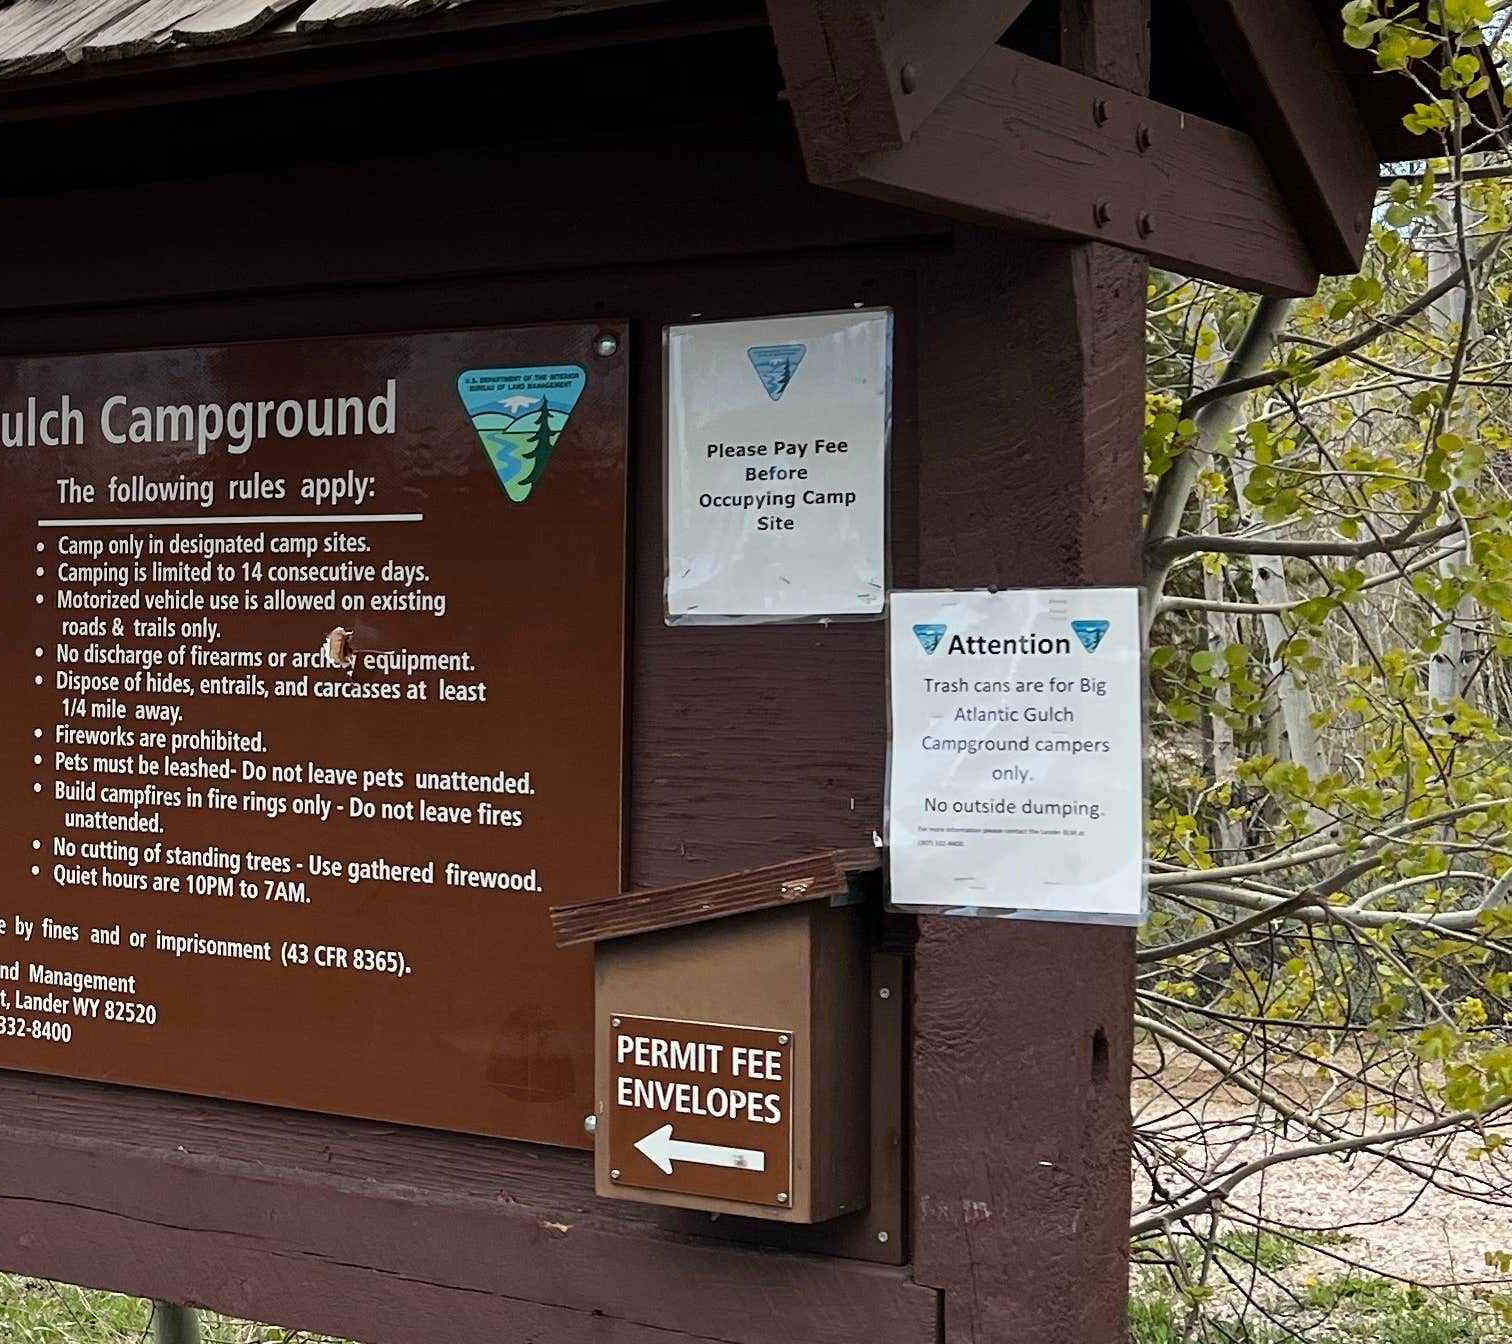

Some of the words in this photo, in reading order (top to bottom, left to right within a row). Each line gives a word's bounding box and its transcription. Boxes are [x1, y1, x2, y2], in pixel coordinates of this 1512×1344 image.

[100, 378, 397, 456] Campground
[707, 443, 768, 459] Please
[774, 441, 809, 459] Pay
[815, 439, 849, 454] Fee
[745, 465, 808, 481] Before
[56, 477, 95, 504] The
[107, 474, 214, 508] following
[229, 471, 286, 500] rules
[300, 469, 375, 506] apply:
[699, 490, 796, 510] Occupying
[802, 490, 856, 507] Camp
[757, 515, 795, 531] Site
[58, 535, 104, 560] Camp
[108, 533, 144, 560] only
[148, 533, 164, 554] in
[169, 531, 265, 559] designated
[270, 537, 318, 558] camp
[323, 531, 371, 553] sites.
[947, 633, 1070, 655] Attention
[57, 643, 79, 663] No
[83, 643, 163, 670] discharge
[167, 644, 187, 665] of
[189, 644, 263, 667] firearms
[267, 651, 288, 667] or
[363, 648, 475, 676] equipment.
[923, 677, 969, 693] Trash
[973, 681, 1011, 693] cans
[1015, 681, 1044, 693] are
[1048, 676, 1075, 693] for
[1079, 677, 1107, 697] Big
[954, 706, 1019, 723] Atlantic
[1023, 706, 1074, 723] Gulch
[55, 723, 135, 747] Fireworks
[139, 732, 167, 749] are
[171, 729, 267, 755] prohibited.
[921, 735, 1030, 755] Campground
[1034, 740, 1111, 755] campers
[991, 765, 1033, 785] only.
[924, 797, 948, 813] No
[952, 798, 1017, 815] outside
[1021, 799, 1105, 820] dumping.
[53, 836, 76, 857] No
[80, 839, 139, 867] cutting
[143, 842, 162, 863] of
[165, 846, 241, 875] standing
[245, 851, 291, 873] trees
[309, 854, 343, 877] Use
[347, 858, 434, 884] gathered
[444, 862, 543, 893] firewood.
[53, 863, 98, 887] Quiet
[102, 866, 148, 890] hours
[152, 875, 180, 893] are
[185, 874, 234, 897] 10PM
[238, 879, 259, 899] to
[263, 879, 311, 904] 7AM.
[15, 915, 34, 941] by
[41, 917, 80, 941] fines
[90, 925, 120, 945] and
[129, 931, 147, 949] or
[156, 929, 271, 961] imprisonment
[281, 941, 309, 967] (43
[314, 945, 348, 968] CFR
[352, 948, 412, 977] 8365).
[29, 963, 136, 995] Management
[15, 989, 70, 1015] Lander
[72, 996, 101, 1018] WY
[104, 1000, 157, 1025] 82520
[617, 1035, 724, 1074] PERMIT
[732, 1046, 782, 1081] FEE
[617, 1076, 781, 1124] ENVELOPES
